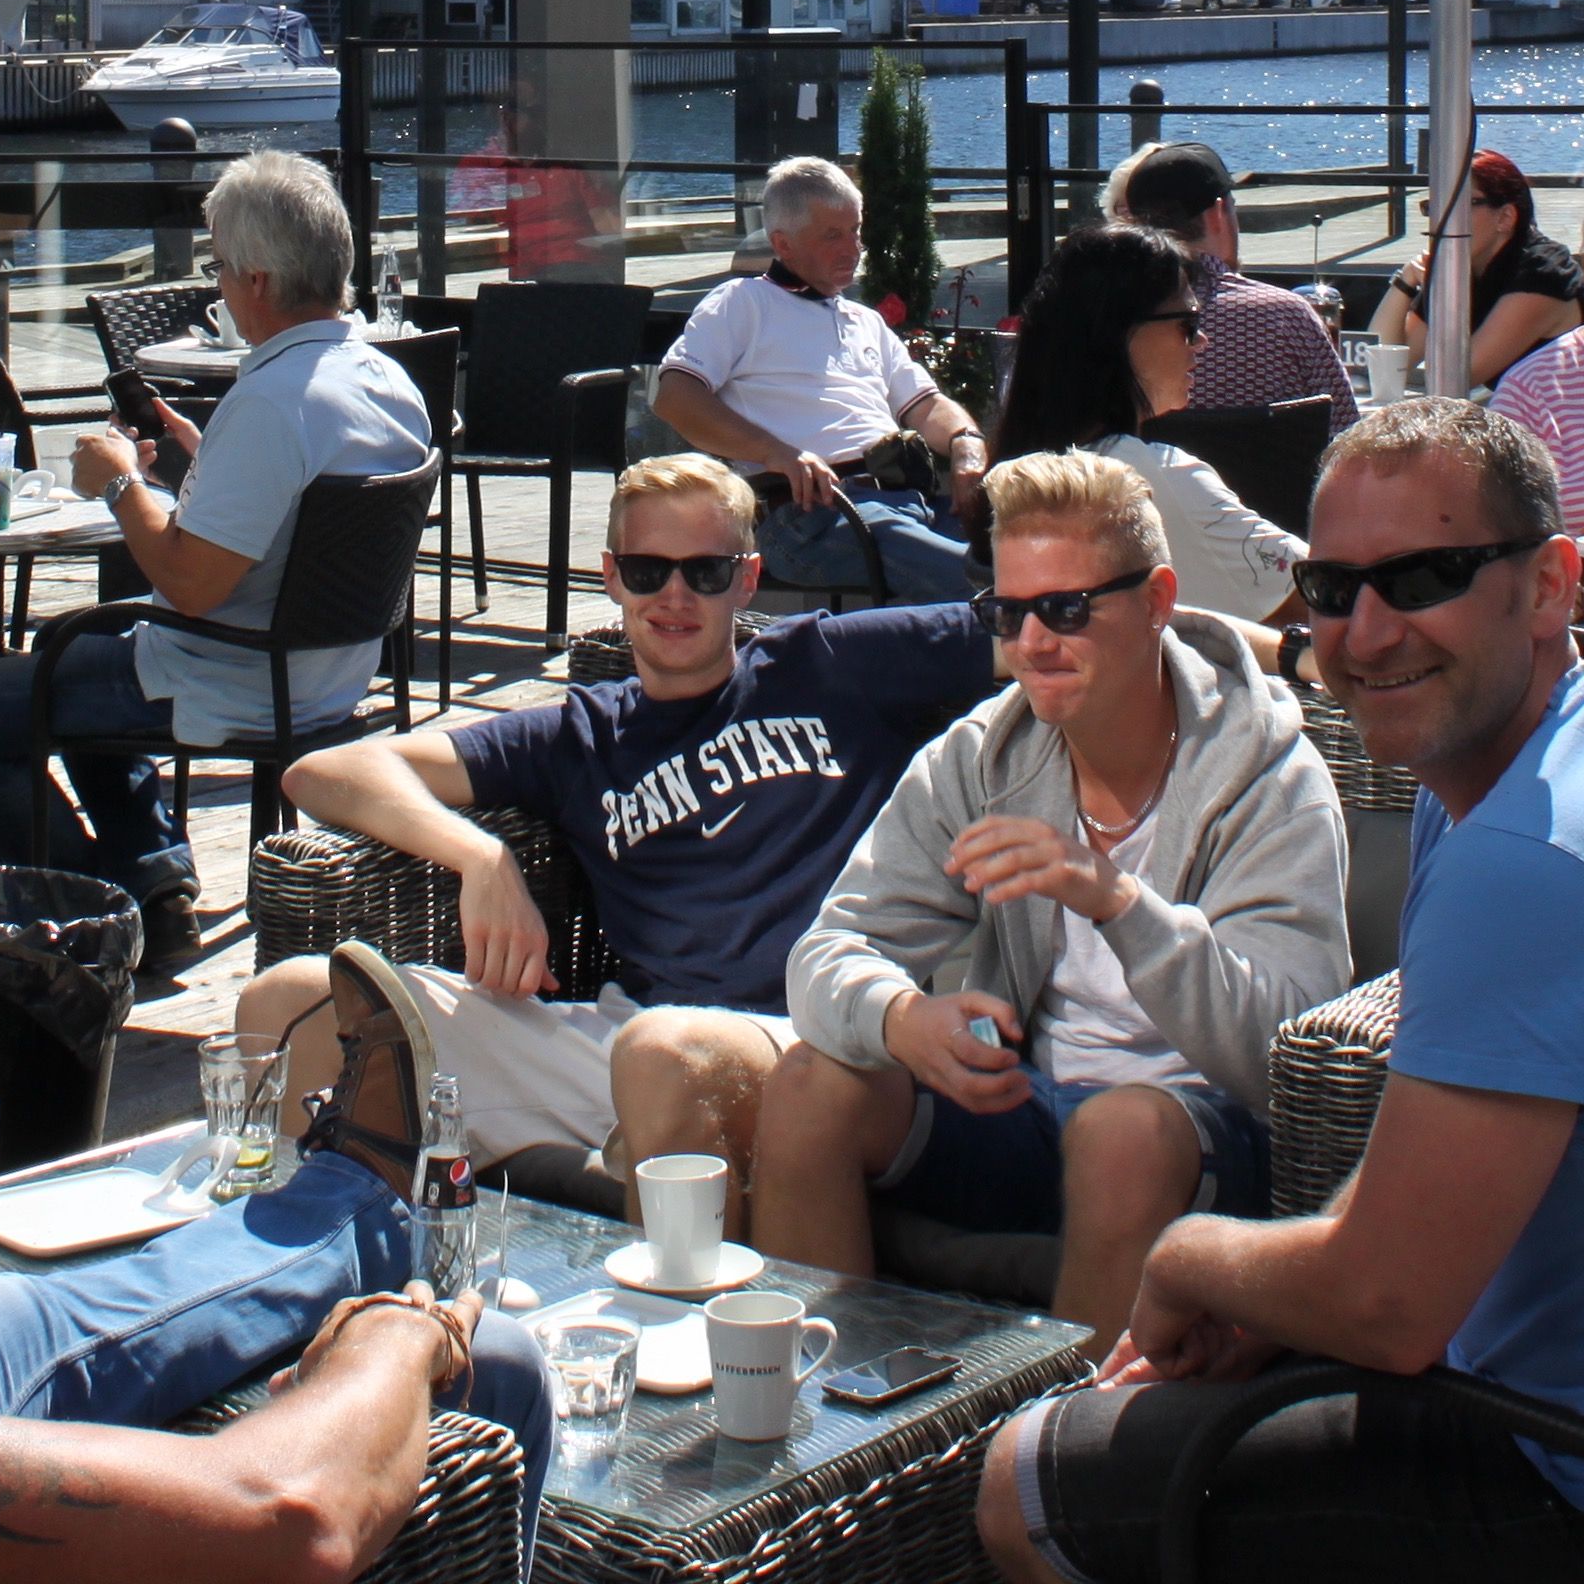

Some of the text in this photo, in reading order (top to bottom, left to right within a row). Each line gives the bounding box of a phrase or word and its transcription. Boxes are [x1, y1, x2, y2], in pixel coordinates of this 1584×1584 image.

[1342, 340, 1370, 367] 18
[601, 716, 845, 861] PENN STATE
